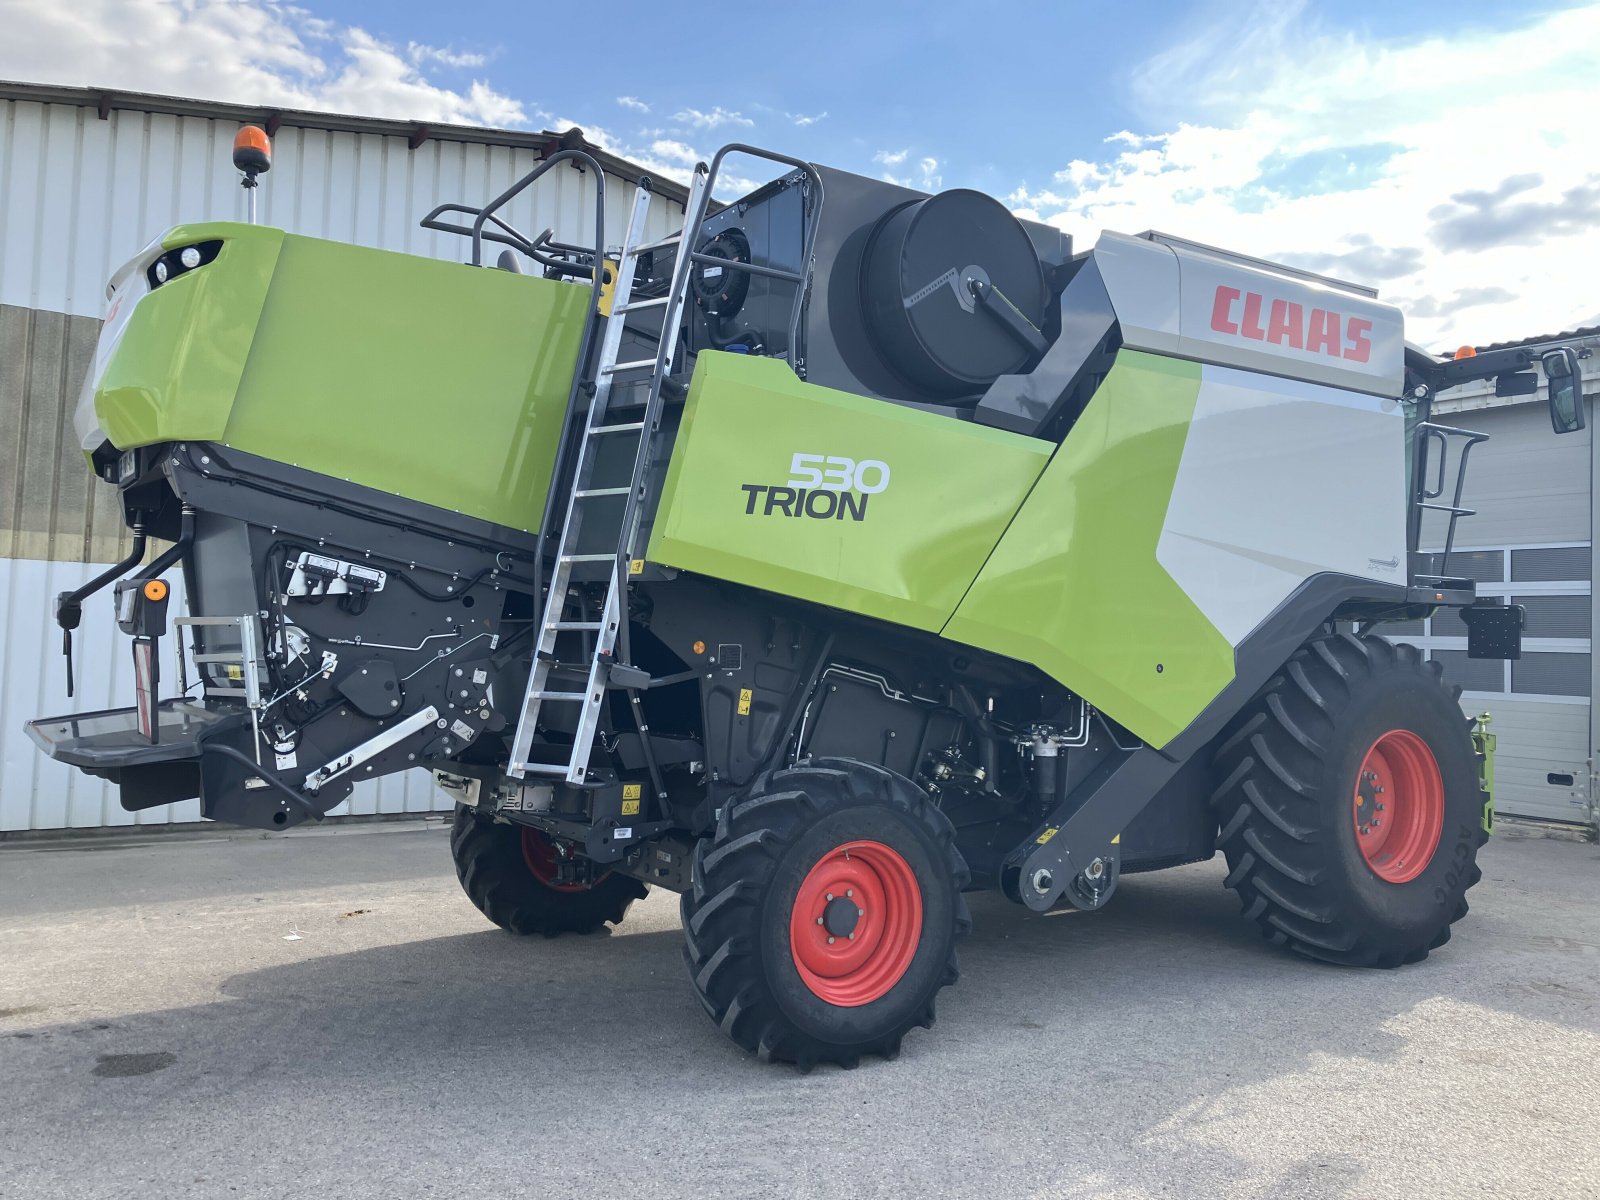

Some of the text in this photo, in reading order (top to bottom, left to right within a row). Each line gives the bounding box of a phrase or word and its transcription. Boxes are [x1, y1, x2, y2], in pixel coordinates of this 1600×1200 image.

[1211, 285, 1373, 363] CLAAS
[787, 452, 891, 494] 530
[741, 484, 869, 521] TRION
[1445, 824, 1473, 890] AC70
